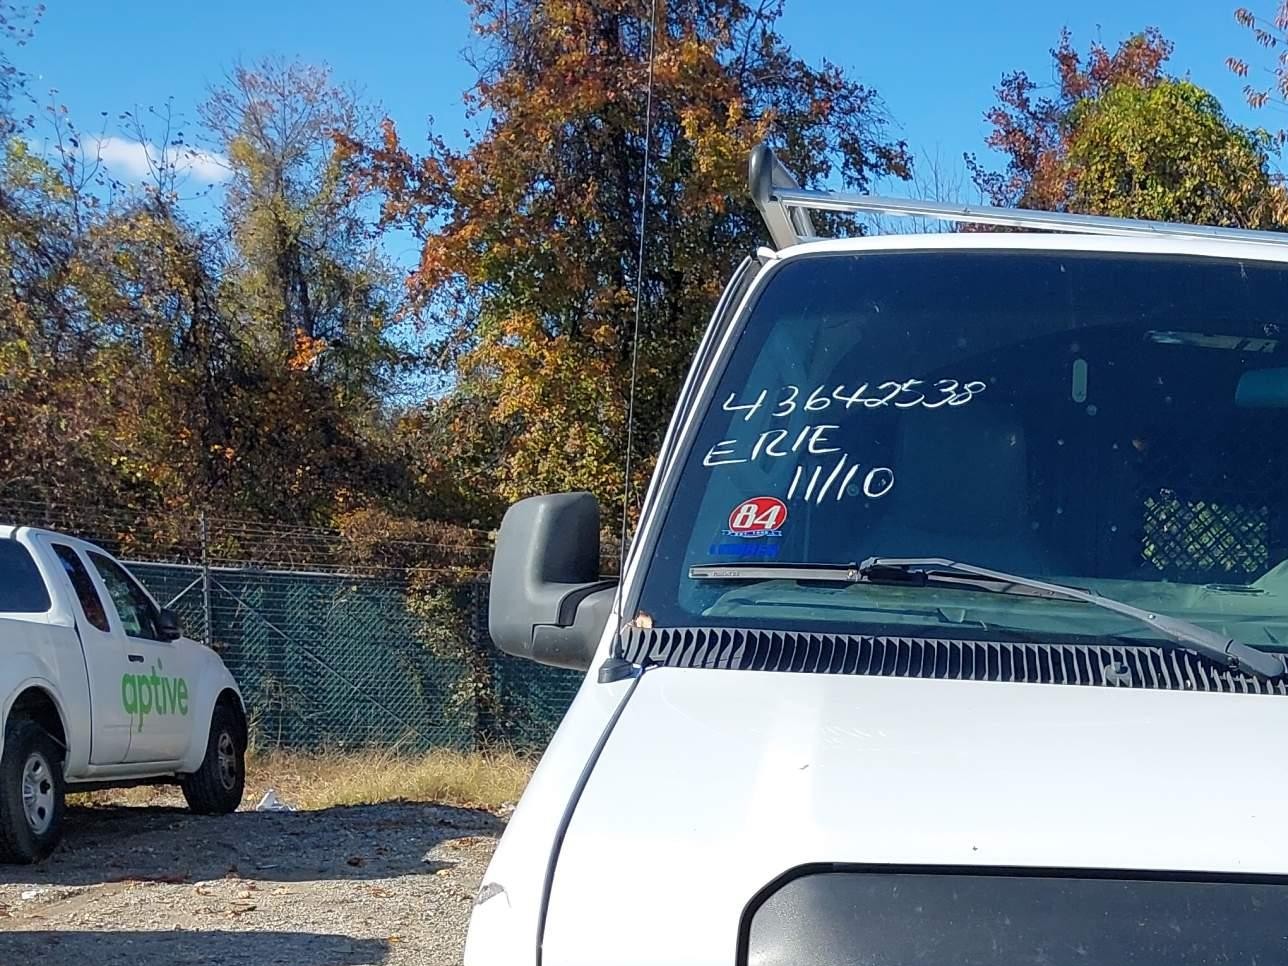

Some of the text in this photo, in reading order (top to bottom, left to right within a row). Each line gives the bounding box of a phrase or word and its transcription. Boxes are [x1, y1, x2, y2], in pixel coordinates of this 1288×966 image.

[722, 378, 987, 422] 43642538
[701, 424, 842, 467] ERIE
[787, 453, 895, 504] 11/10
[733, 504, 781, 529] 84
[121, 657, 189, 733] aptive
